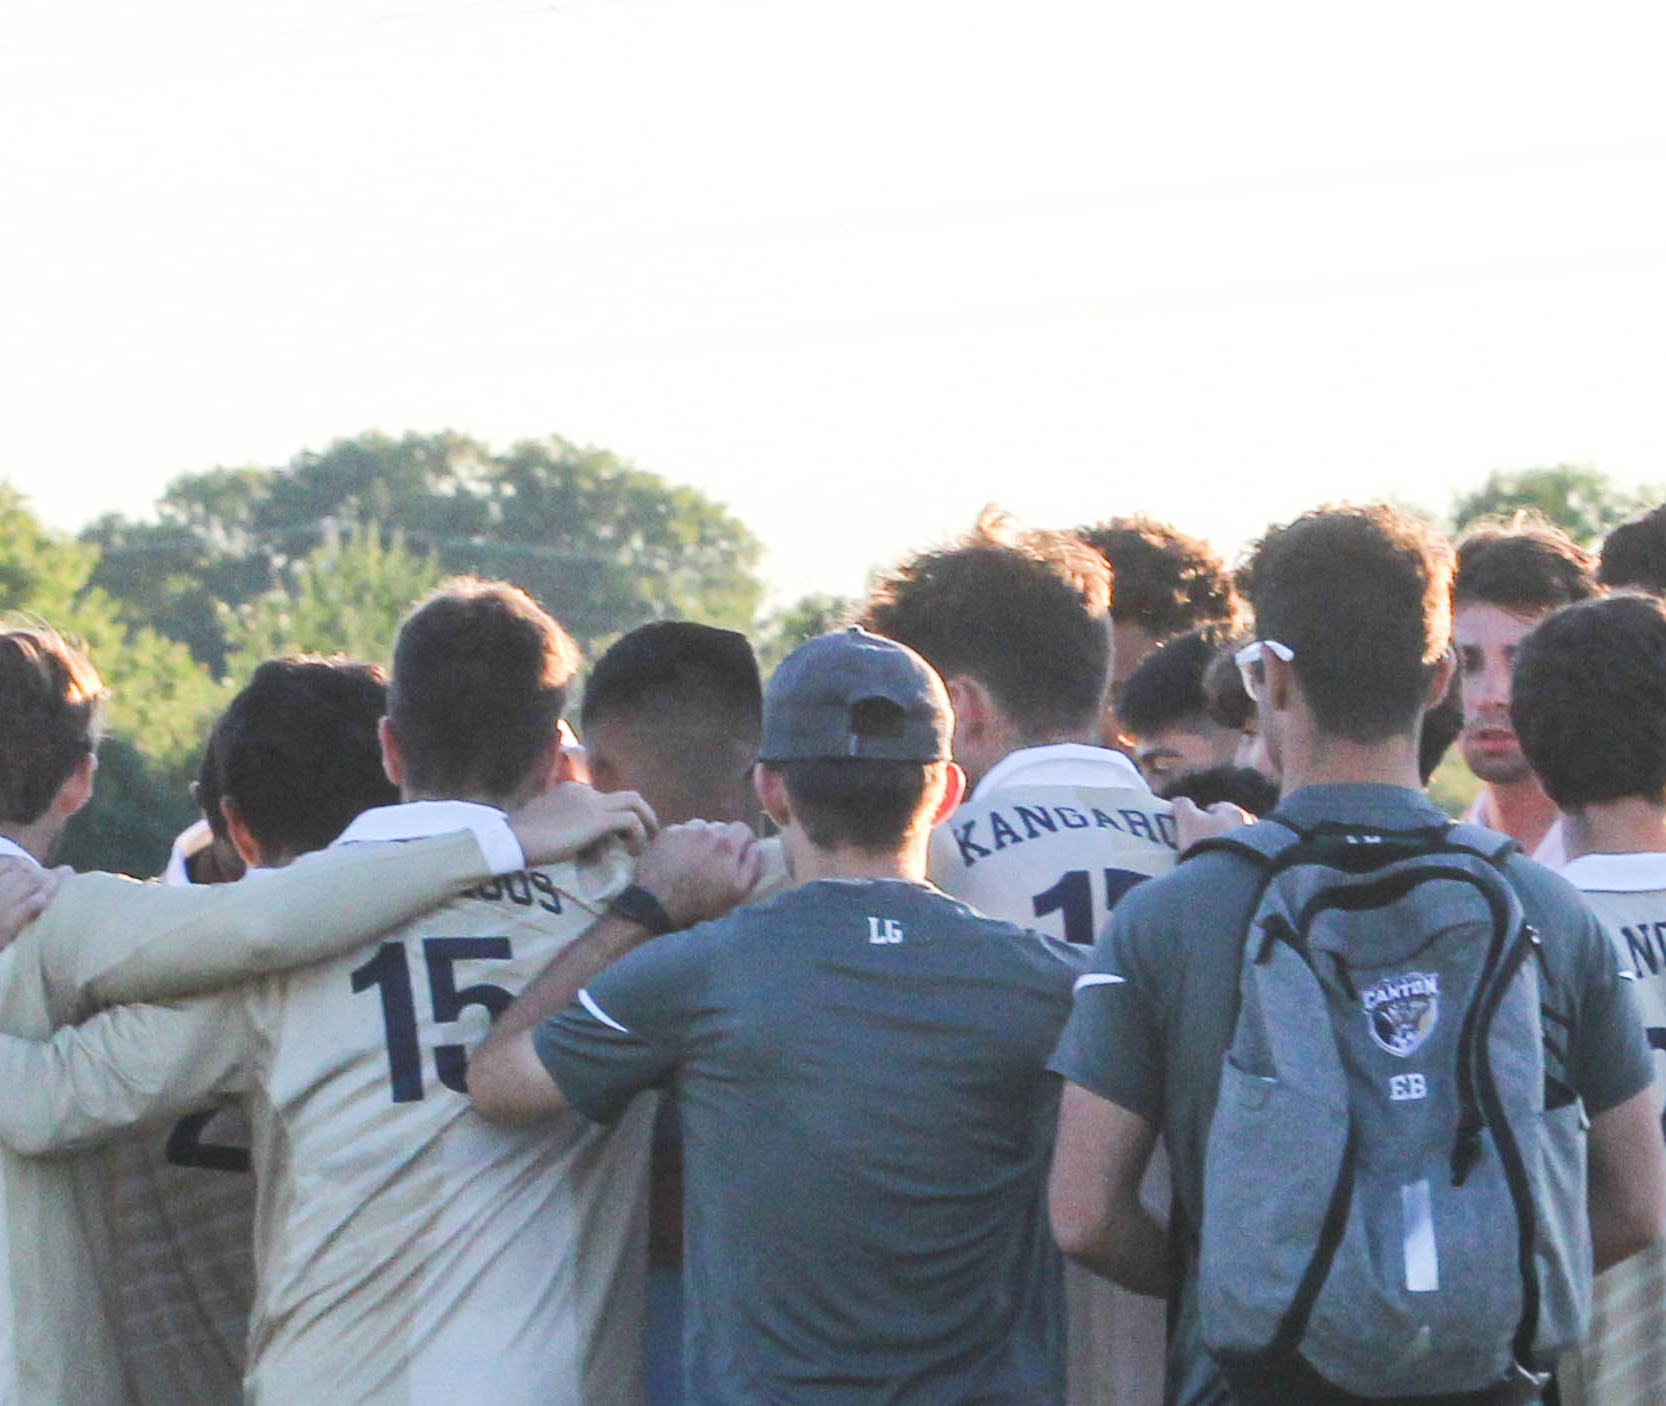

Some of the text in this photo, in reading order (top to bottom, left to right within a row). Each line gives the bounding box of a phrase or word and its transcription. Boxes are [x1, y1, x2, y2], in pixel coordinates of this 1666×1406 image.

[953, 805, 1179, 867] KANGARO
[867, 916, 904, 944] LG
[1362, 973, 1440, 1009] CANTON
[351, 936, 518, 1103] 15
[1389, 1073, 1427, 1100] EB
